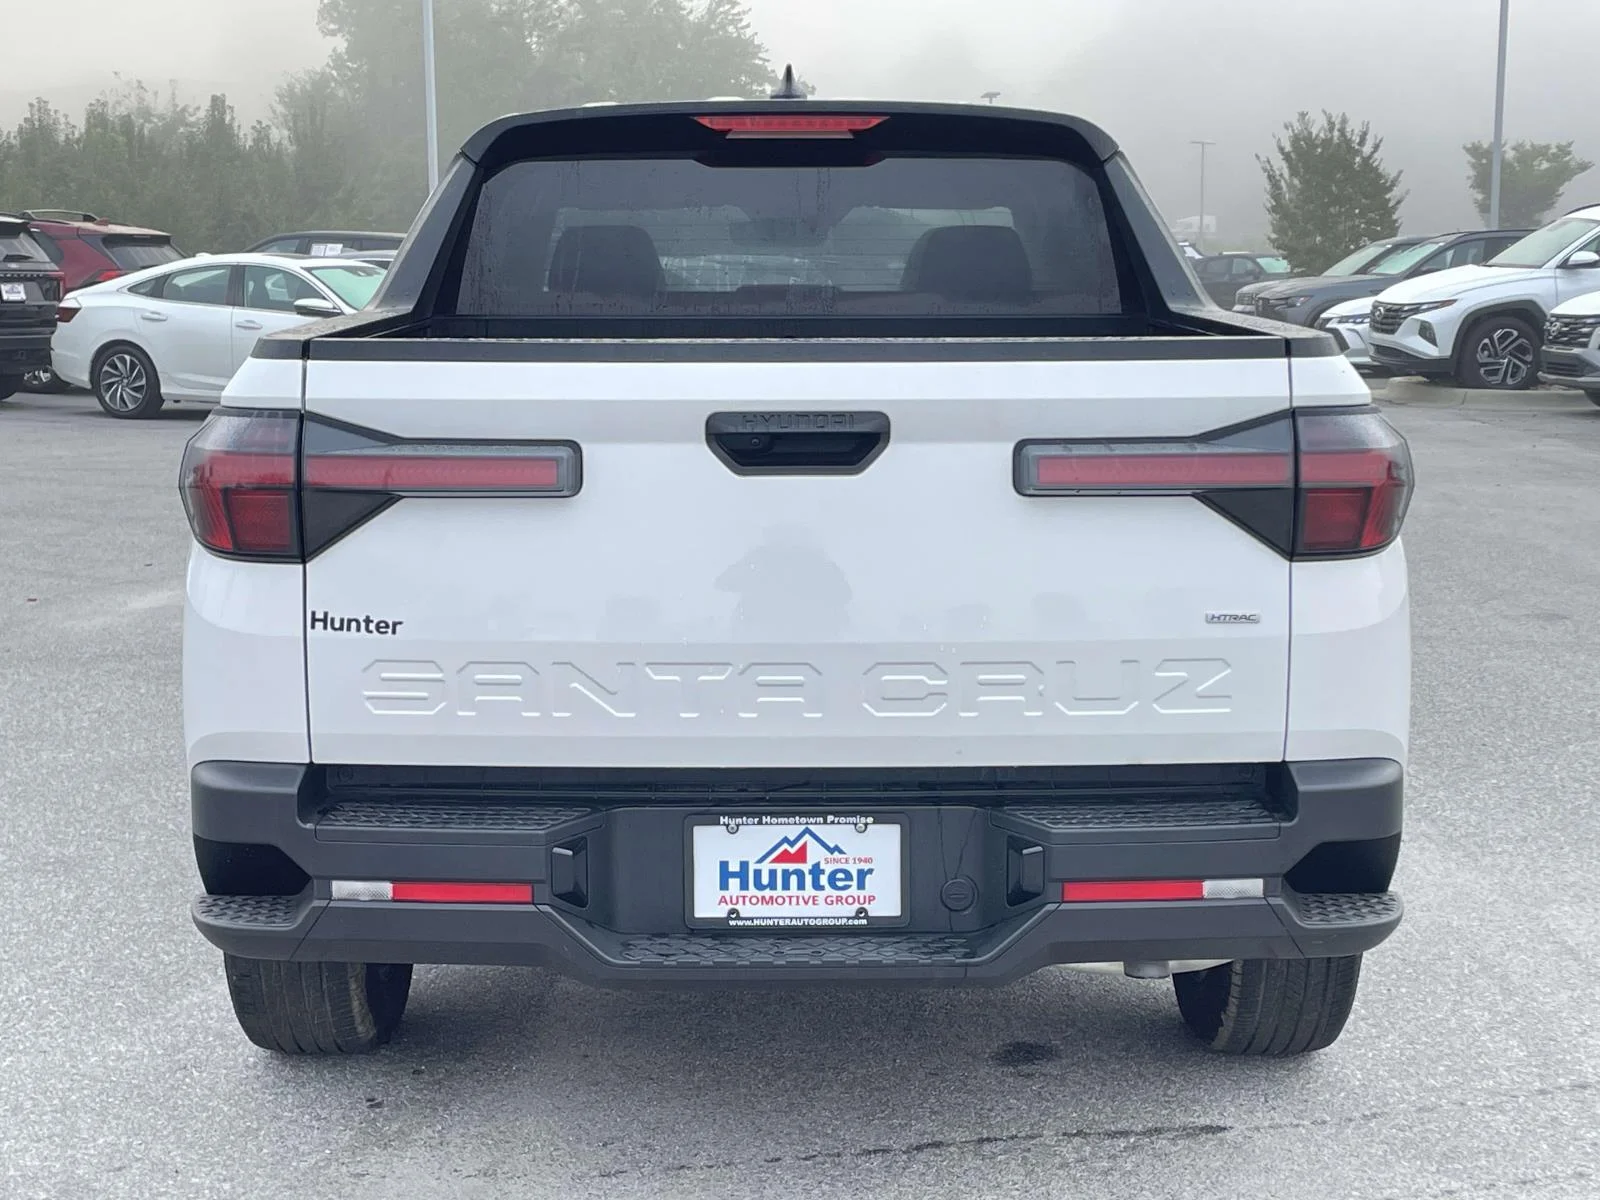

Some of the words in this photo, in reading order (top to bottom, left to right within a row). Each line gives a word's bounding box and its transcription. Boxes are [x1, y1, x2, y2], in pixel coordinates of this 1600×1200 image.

[742, 414, 854, 430] HYUNDAI
[310, 610, 404, 635] Hunter
[1209, 613, 1258, 622] HTRAC
[363, 659, 823, 718] SANTA
[862, 658, 1232, 717] CRUZ
[719, 815, 759, 826] Hunter
[762, 815, 823, 825] Hometown
[826, 815, 874, 825] Promise
[823, 857, 850, 865] SINCE
[852, 857, 874, 865] 1940
[718, 860, 875, 892] Hunter
[717, 895, 820, 906] AUTOMOTIVE
[824, 894, 876, 906] GROUP
[728, 917, 868, 926] www.HUNTERAUTOGROUP.com
